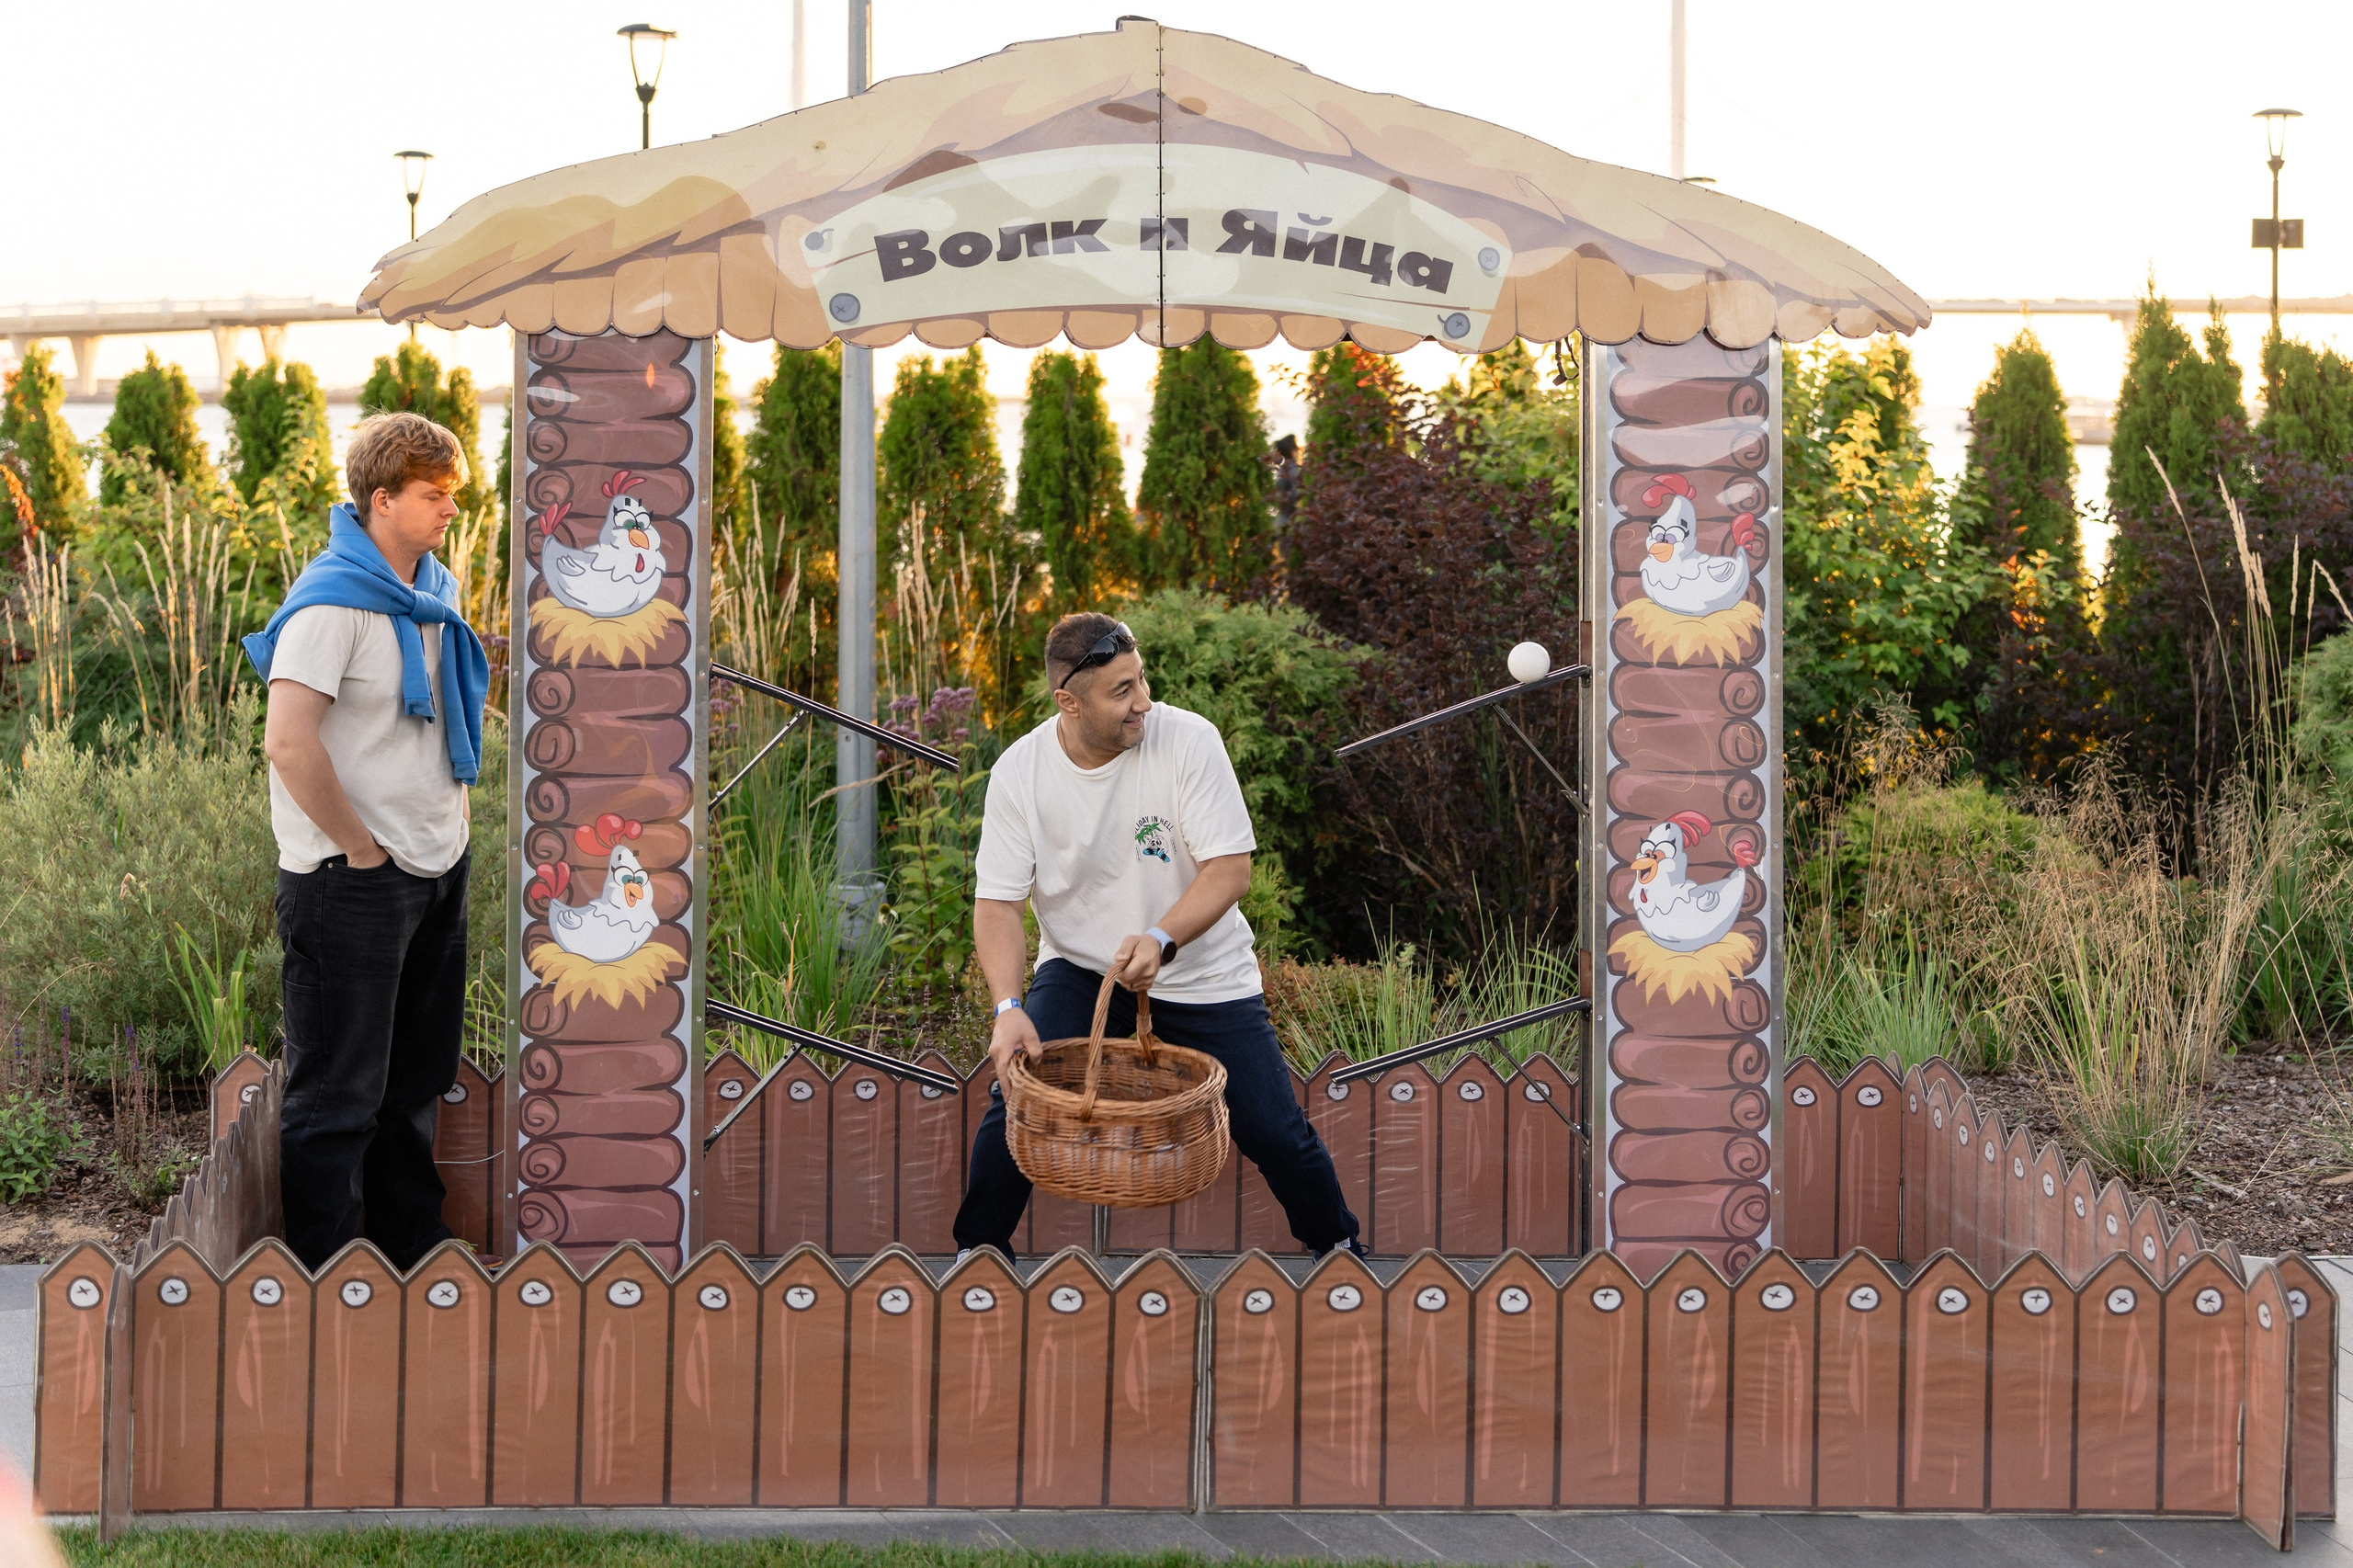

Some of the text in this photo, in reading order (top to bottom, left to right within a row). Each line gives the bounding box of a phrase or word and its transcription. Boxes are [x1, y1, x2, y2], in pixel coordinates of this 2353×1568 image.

[874, 208, 1454, 294] Волк и Яйца
[1159, 817, 1174, 832] HELL
